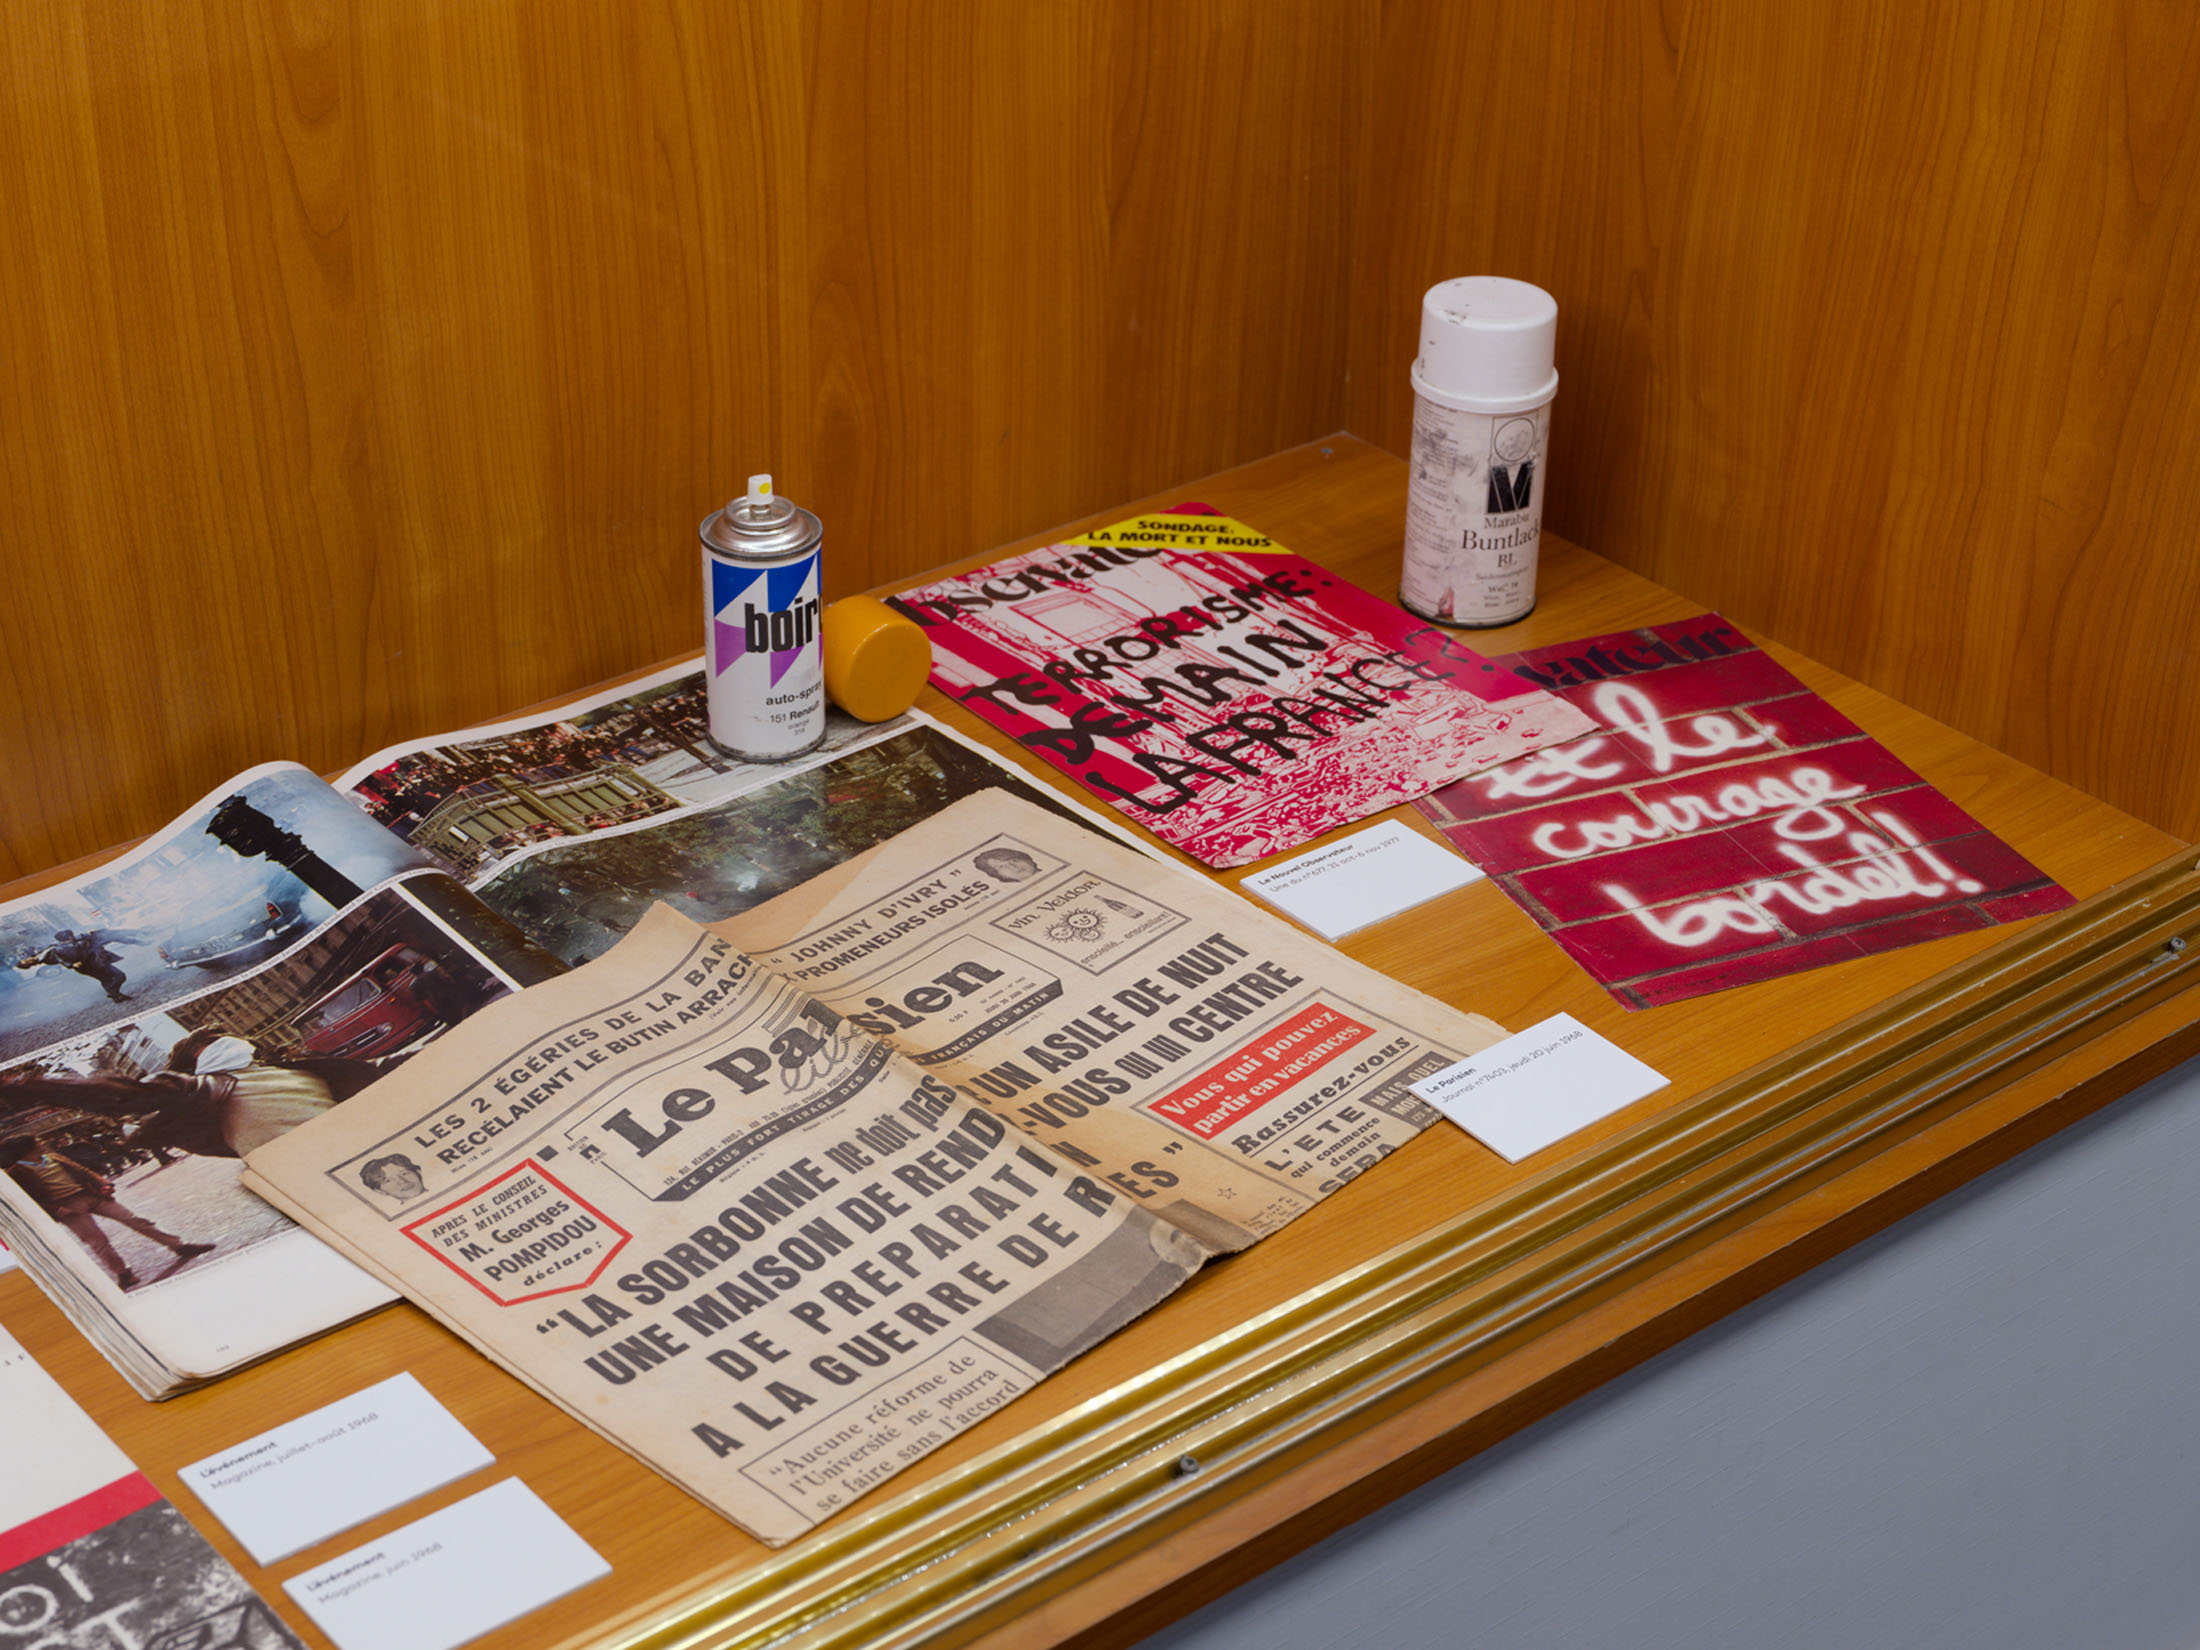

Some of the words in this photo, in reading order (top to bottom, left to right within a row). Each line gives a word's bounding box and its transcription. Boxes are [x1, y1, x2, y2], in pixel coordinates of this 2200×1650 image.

[1088, 531, 1112, 541] LA
[1119, 532, 1178, 543] MORT
[1186, 535, 1209, 545] ET
[1216, 536, 1272, 547] NOUS
[1484, 514, 1529, 529] Marabu
[744, 594, 822, 653] boir
[961, 569, 1332, 715] TERRORISME:
[1019, 619, 1328, 764] DEMAIN
[1531, 766, 1867, 859] courage
[1271, 865, 1302, 880] Nouvel
[1603, 812, 1984, 948] bordel!
[413, 1112, 466, 1149] LES
[470, 1098, 492, 1115] 2
[494, 1028, 600, 1096] ÉGÉRIES
[604, 1010, 643, 1031] DE
[644, 989, 682, 1012] LA
[789, 919, 874, 964] JOHNNY
[877, 879, 948, 920] D'IVRY
[436, 1067, 576, 1166] RECÉLAIENT
[572, 1047, 608, 1073] LE
[607, 1021, 678, 1057] BUTIN
[793, 914, 928, 982] PROMENEURS
[926, 878, 991, 920] ISOLÉS
[681, 1176, 701, 1192] LE
[706, 1148, 741, 1175] PLUS
[748, 1124, 781, 1147] FORT
[787, 1099, 834, 1124] TIRAGE
[839, 1073, 865, 1095] DES
[992, 1016, 1008, 1028] DU
[1013, 992, 1048, 1016] MATIN
[1161, 1081, 1226, 1117] Vous
[1224, 1054, 1263, 1084] qui
[1262, 1010, 1339, 1062] pouvez
[1193, 1091, 1253, 1135] partir
[1249, 1077, 1281, 1098] en
[1273, 1024, 1362, 1080] vacances
[1231, 1036, 1411, 1155] Rassurez-vous
[1425, 1083, 1440, 1094] Le
[1440, 1067, 1477, 1087] Parisien
[1442, 1082, 1475, 1104] Journal
[1508, 1056, 1532, 1073] jeudi
[1531, 1048, 1545, 1061] 20
[1545, 1041, 1562, 1056] juin
[1560, 1030, 1584, 1047] 1968
[601, 1087, 716, 1159] Le
[617, 1157, 840, 1306] SORBONNE
[824, 1141, 876, 1175] ne
[855, 1113, 921, 1157] doit
[899, 1074, 957, 1133] pas
[969, 1060, 1043, 1099] UN
[1023, 1004, 1136, 1074] ASILE
[1112, 977, 1181, 1018] DE
[1156, 932, 1250, 990] NUIT
[1290, 1161, 1314, 1179] qui
[1315, 1117, 1381, 1162] commence
[1329, 1132, 1382, 1168] demain
[431, 1214, 468, 1239] APRÈS
[471, 1203, 489, 1217] LE
[491, 1175, 537, 1206] CONSEIL
[583, 1323, 691, 1385] UNE
[672, 1216, 855, 1339] MAISON
[835, 1182, 913, 1234] DE
[1114, 1051, 1165, 1080] ou
[1141, 1034, 1193, 1063] un
[1168, 961, 1304, 1043] CENTRE
[443, 1229, 470, 1248] DES
[475, 1184, 548, 1232] MINISTRES
[458, 1242, 495, 1263] M.
[491, 1199, 571, 1245] Georges
[483, 1214, 597, 1282] POMPIDOU
[691, 1421, 746, 1459] A
[733, 1379, 819, 1431] LA
[807, 1260, 1010, 1386] GUERRE
[999, 1212, 1080, 1269] DE
[706, 1330, 792, 1383] DE
[348, 1411, 379, 1430] 1968
[865, 1372, 948, 1424] réforme
[949, 1353, 976, 1376] de
[789, 1423, 902, 1496] l'Université
[906, 1406, 933, 1427] ne
[938, 1368, 999, 1414] pourra
[816, 1491, 843, 1513] se
[848, 1458, 896, 1495] faire
[896, 1428, 943, 1462] sans
[946, 1379, 1021, 1431] l'accord
